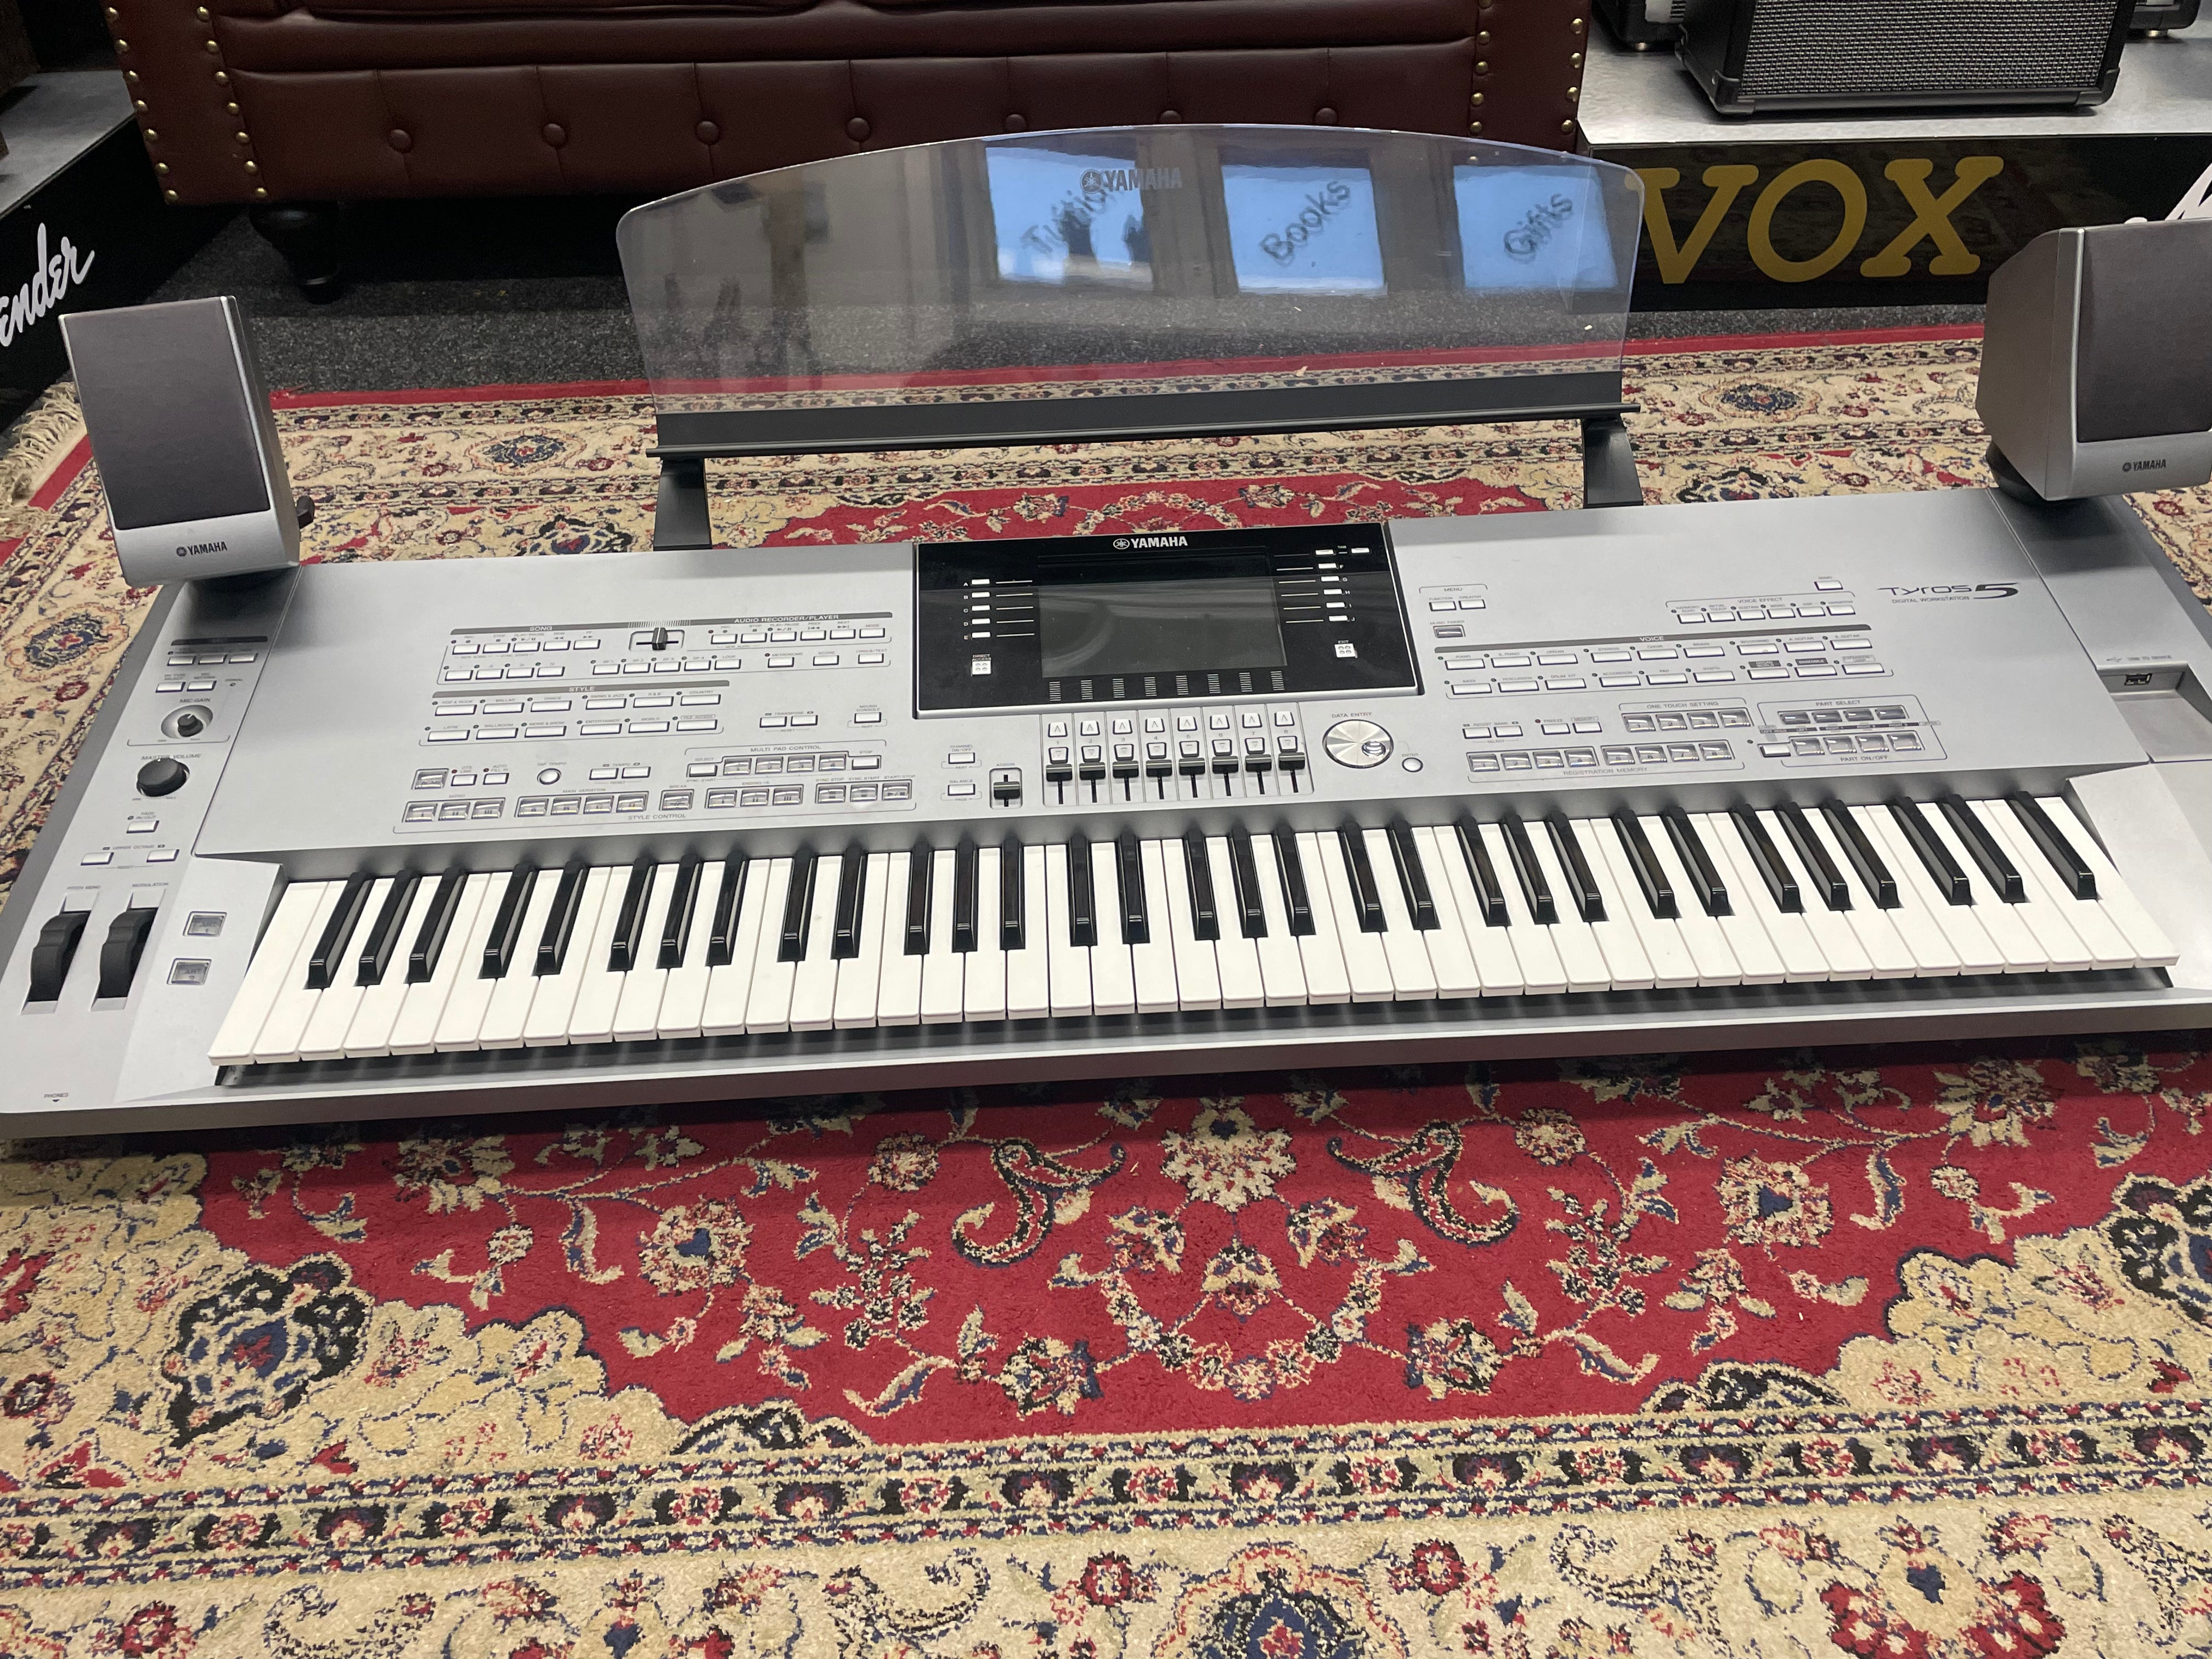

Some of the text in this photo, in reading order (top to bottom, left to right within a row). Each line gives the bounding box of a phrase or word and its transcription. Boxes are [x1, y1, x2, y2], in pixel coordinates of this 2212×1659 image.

[1104, 167, 1182, 192] YAMAHA
[1260, 180, 1351, 263] Books
[1504, 193, 1573, 258] Gifts
[1625, 156, 2004, 285] VOX
[0, 222, 95, 347] ender
[2133, 459, 2166, 471] YAMAHA
[187, 541, 228, 556] YAMAHA
[1131, 535, 1188, 549] YAMAHA
